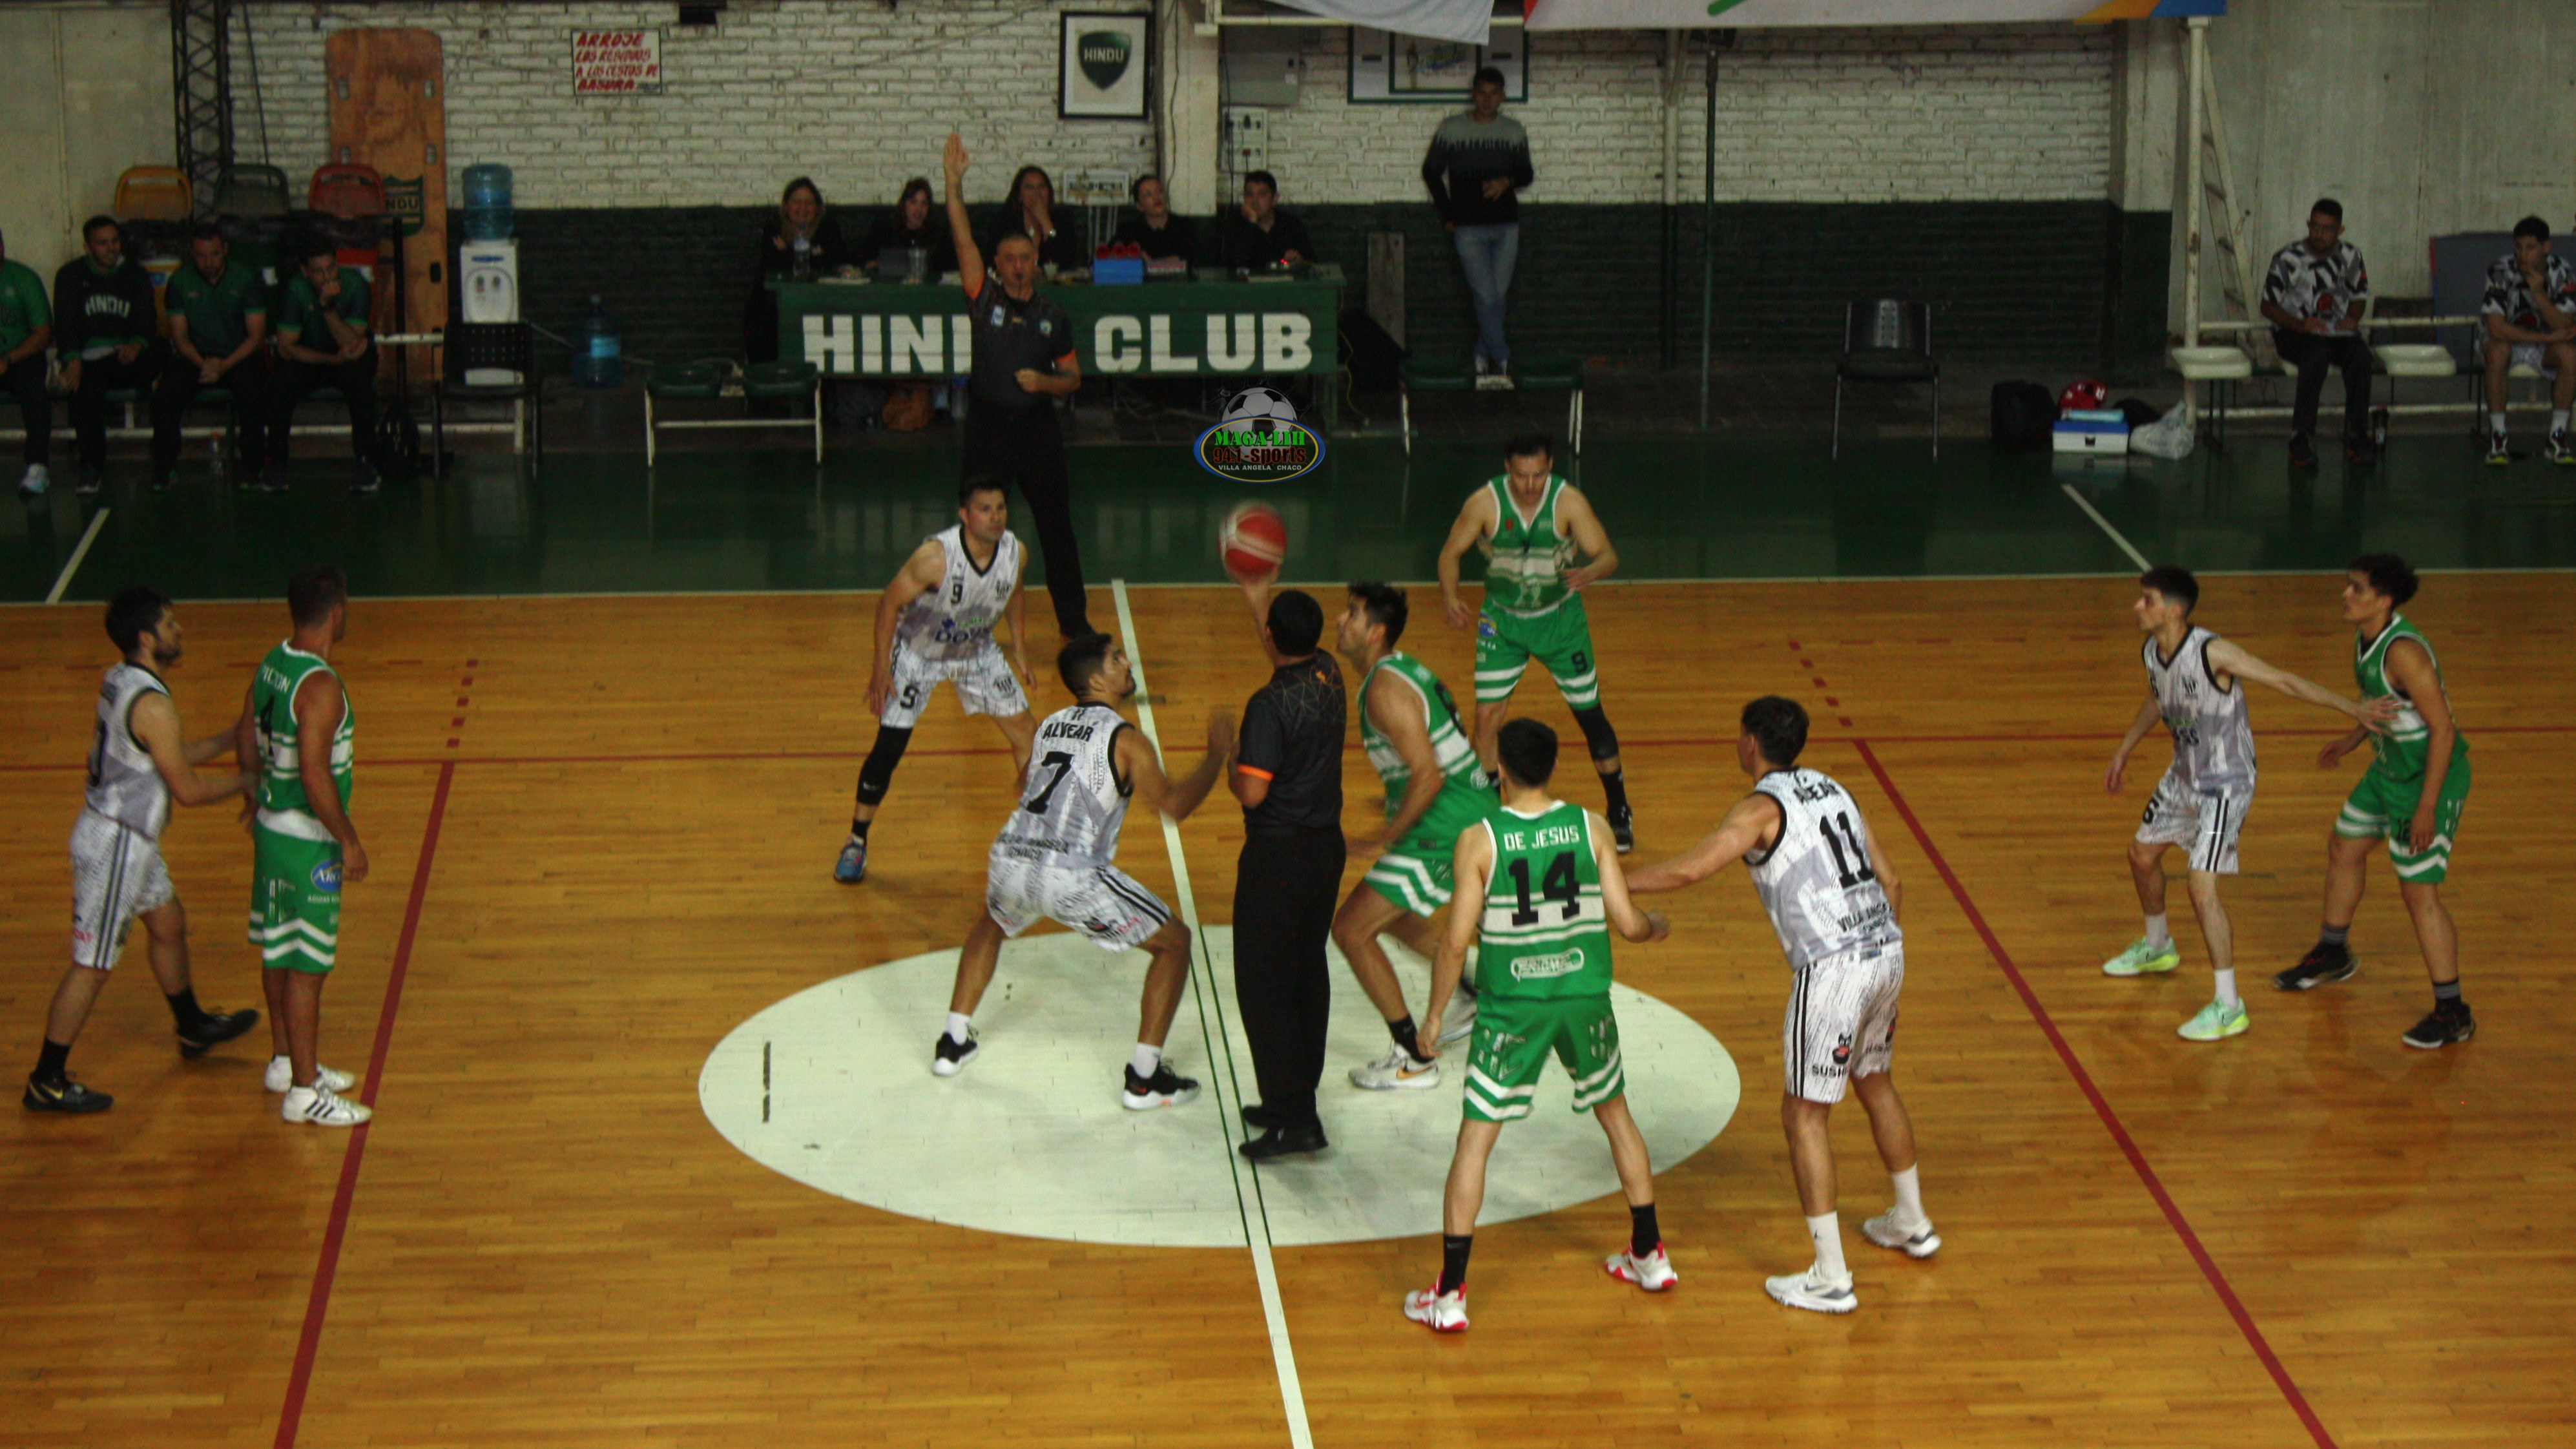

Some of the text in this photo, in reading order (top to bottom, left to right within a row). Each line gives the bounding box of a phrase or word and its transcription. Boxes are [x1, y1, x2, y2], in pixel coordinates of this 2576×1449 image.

[576, 32, 645, 47] ARROJE
[1084, 47, 1124, 63] HINDU
[1094, 312, 1313, 373] CLUB
[950, 583, 964, 605] 9
[1571, 651, 1588, 674] 9
[899, 684, 919, 709] 9
[260, 694, 275, 756] 4
[1042, 721, 1094, 742] ALVEAR
[1026, 751, 1075, 815] 7
[2143, 797, 2160, 824] 6
[1503, 824, 1581, 852] DE JESUS
[1819, 809, 1876, 890] 11
[1508, 851, 1581, 927] 14
